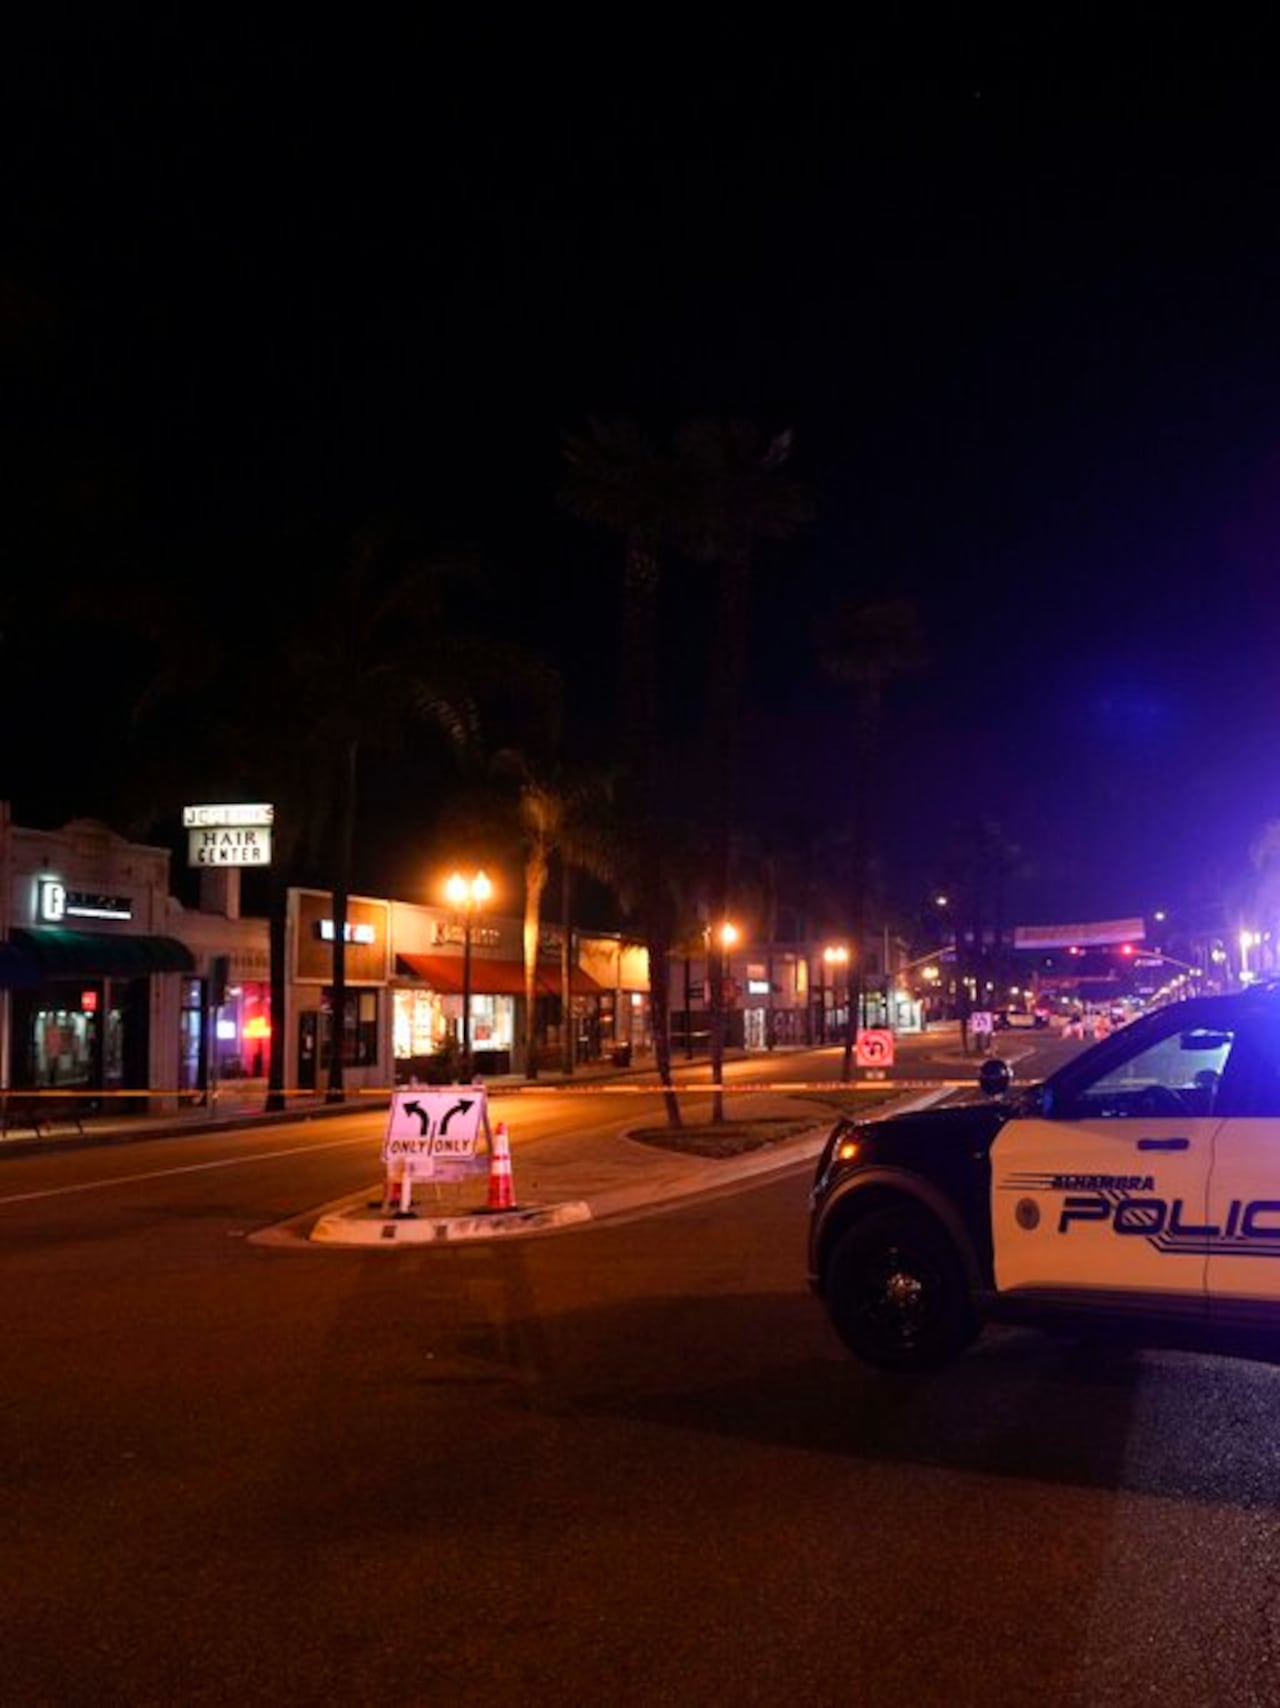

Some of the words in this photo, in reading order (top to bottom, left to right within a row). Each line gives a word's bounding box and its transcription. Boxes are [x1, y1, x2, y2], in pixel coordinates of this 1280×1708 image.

[203, 831, 256, 846] HAIR
[198, 847, 261, 863] CENTER
[391, 1139, 428, 1154] ONLY
[434, 1139, 470, 1153] ONLY
[1051, 1175, 1155, 1191] ALHAMBRA
